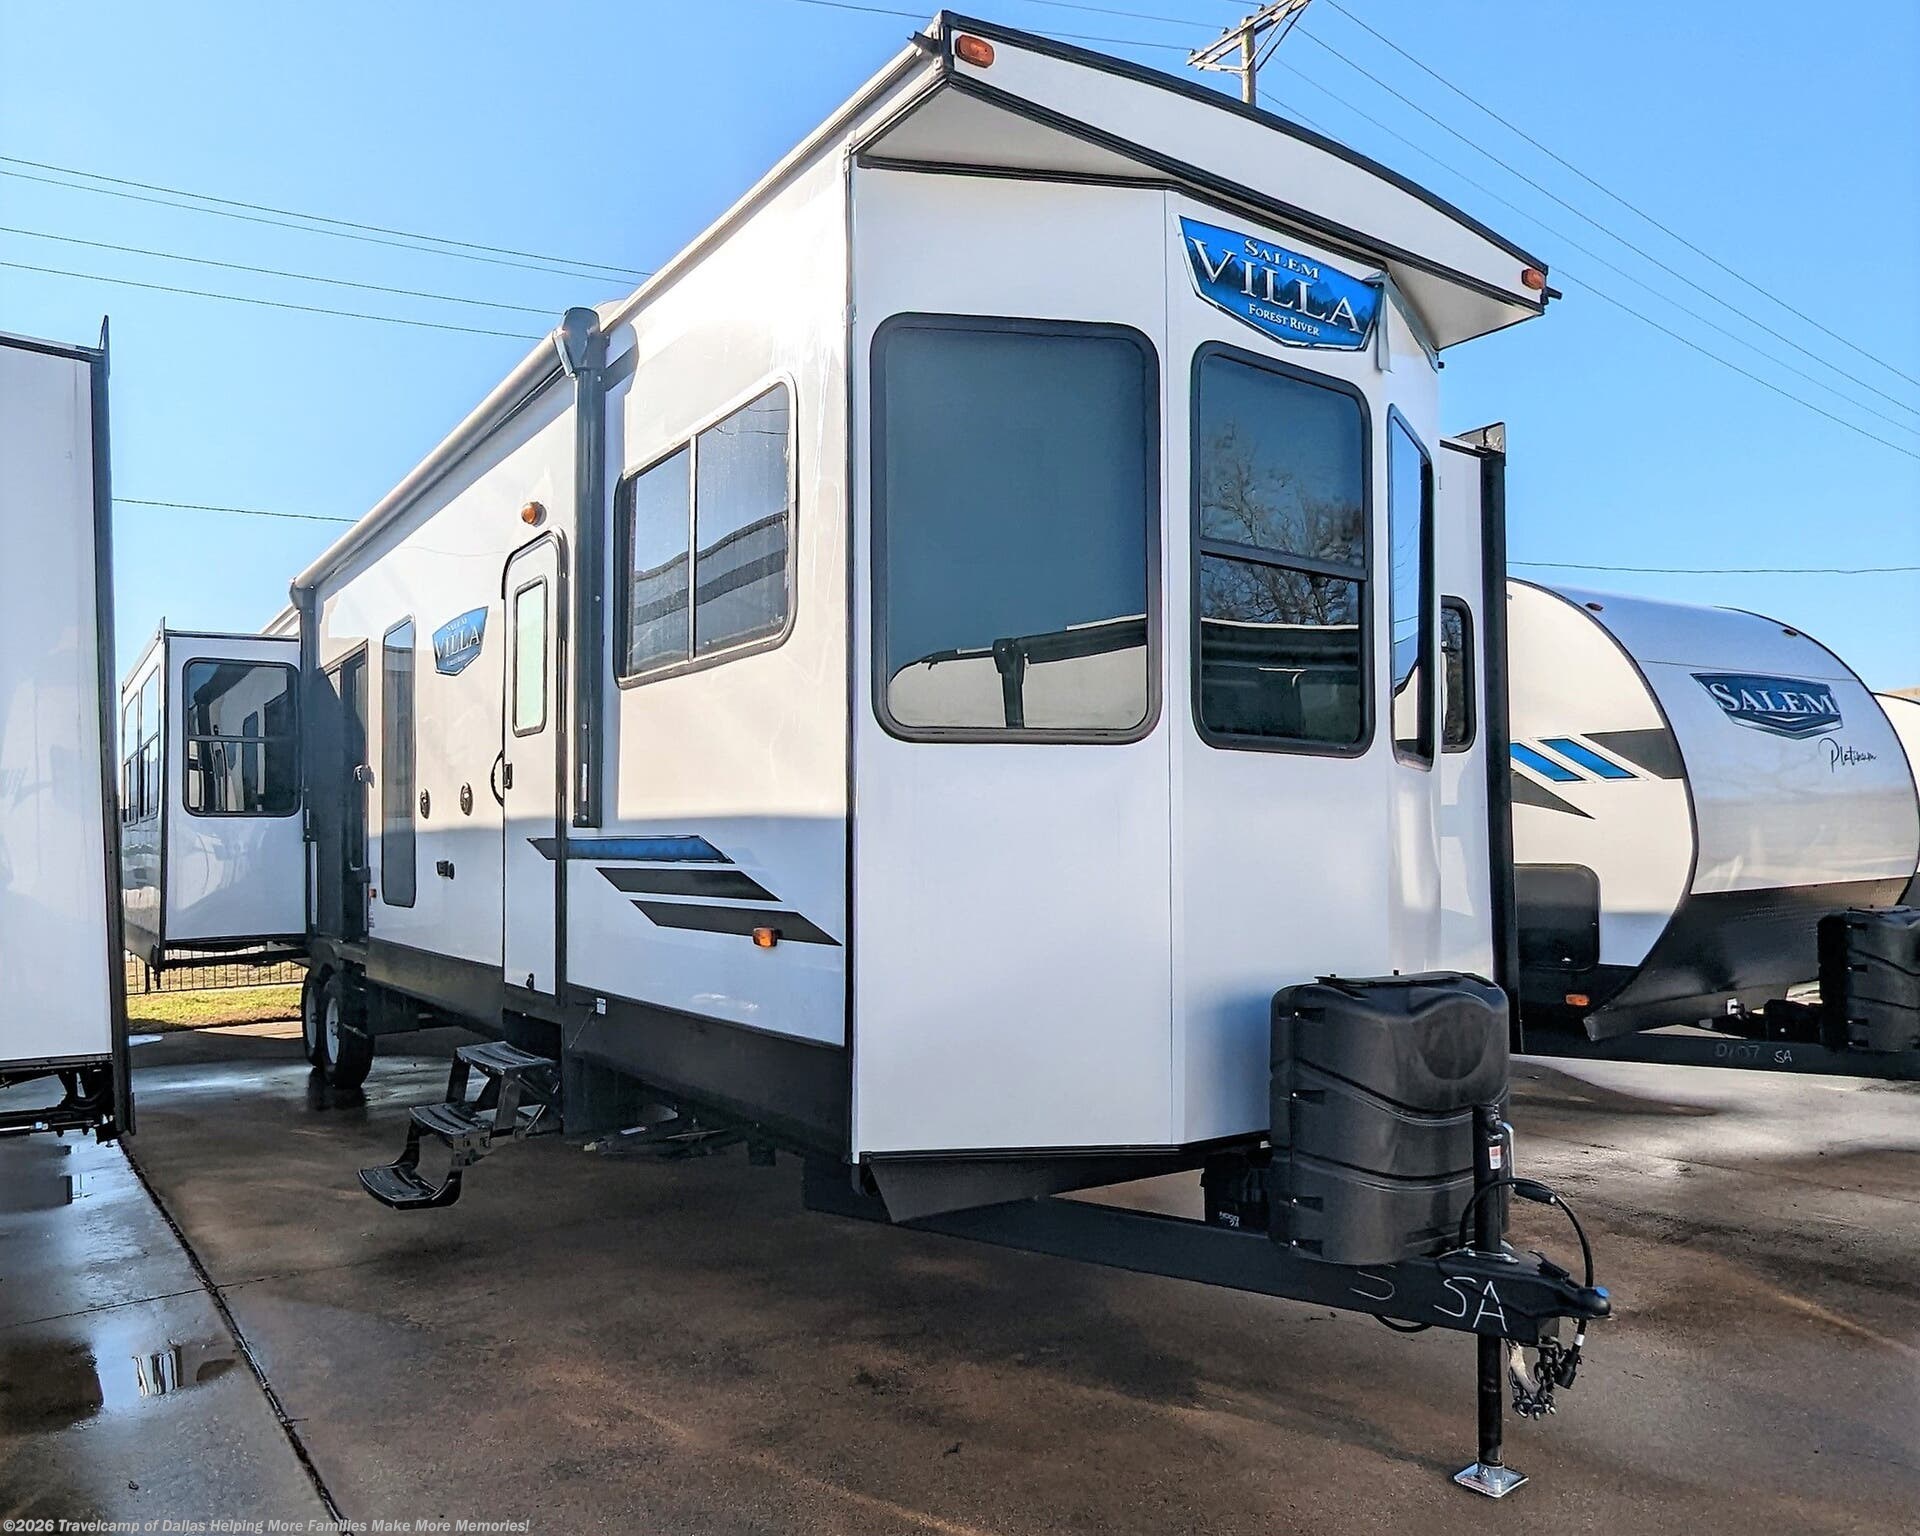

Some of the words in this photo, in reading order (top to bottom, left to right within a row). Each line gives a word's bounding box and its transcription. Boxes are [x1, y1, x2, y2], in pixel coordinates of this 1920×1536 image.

[1244, 239, 1319, 279] SALEM
[1188, 237, 1364, 334] VILLA
[1248, 303, 1288, 326] FOREST
[1290, 315, 1320, 337] RIVER
[435, 625, 480, 659] VILLA
[1709, 683, 1840, 716] SALEM
[1774, 1050, 1792, 1064] SA
[1433, 1276, 1508, 1333] SA
